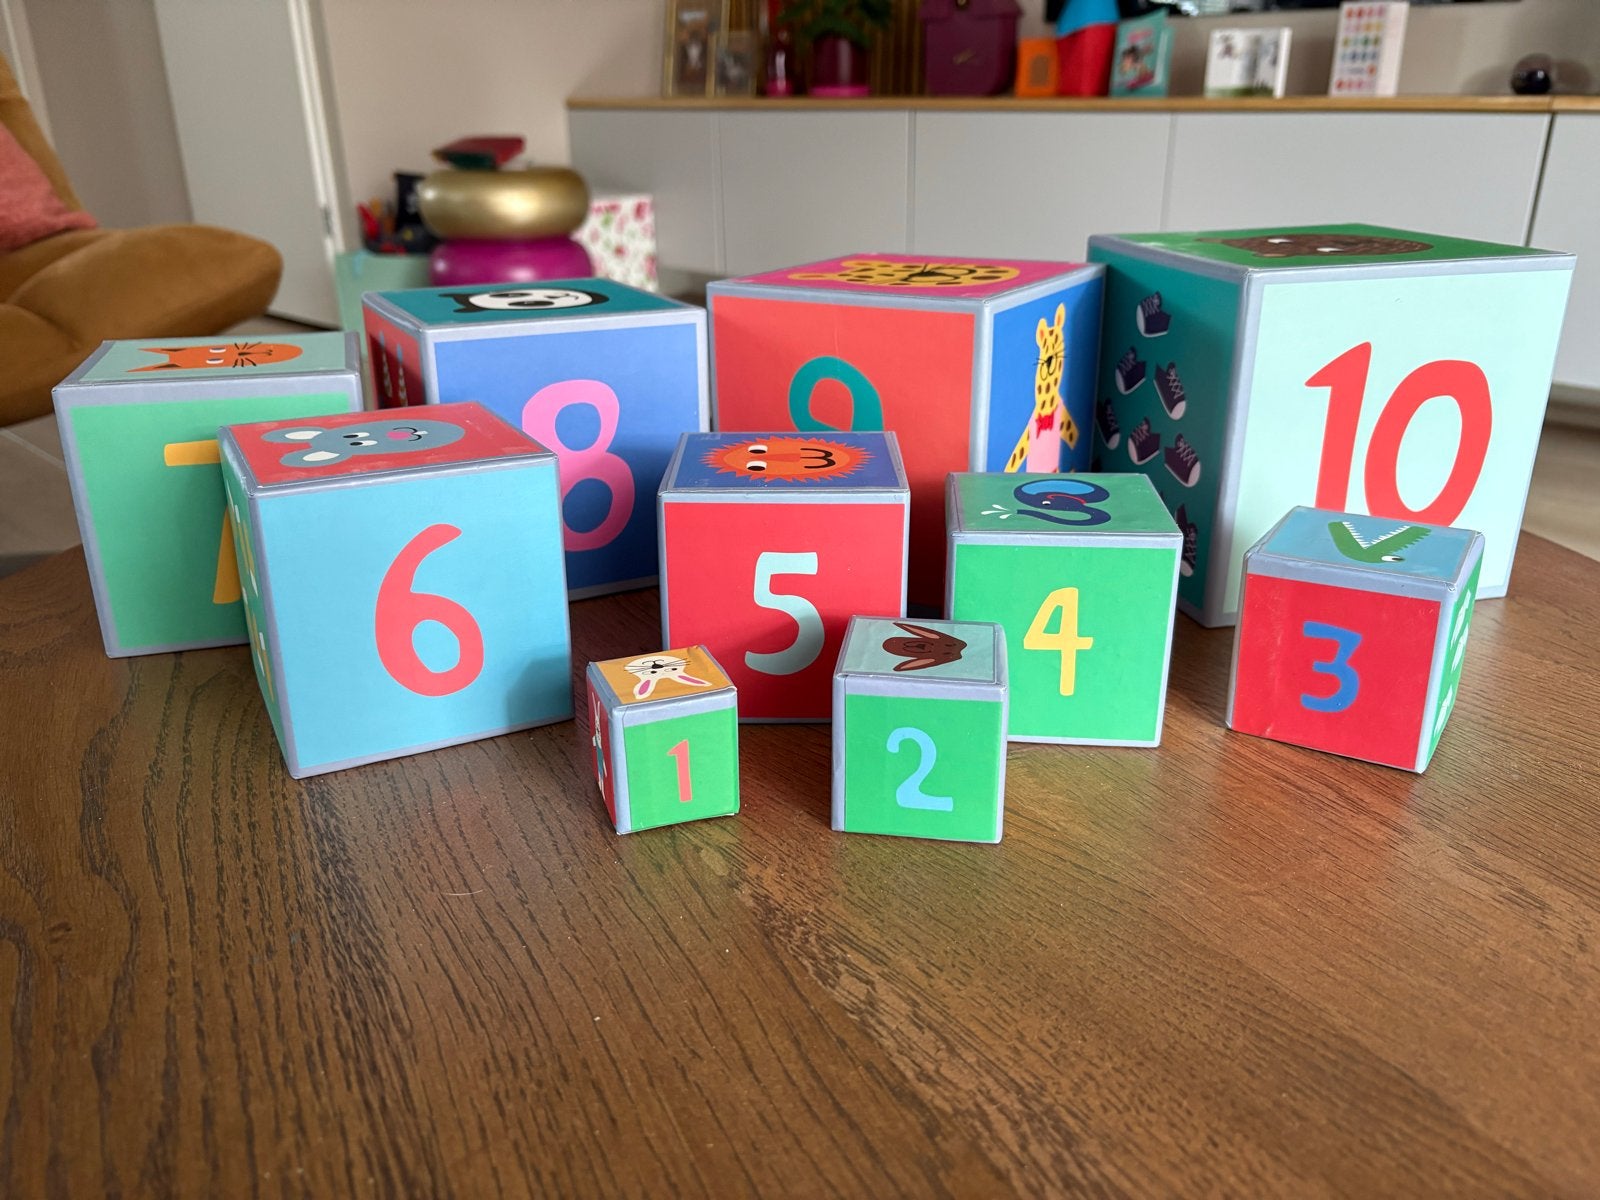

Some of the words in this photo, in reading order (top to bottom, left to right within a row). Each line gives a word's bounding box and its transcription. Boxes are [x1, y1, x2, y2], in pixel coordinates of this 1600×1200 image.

[521, 379, 636, 552] 8
[1304, 341, 1492, 527] 10
[376, 524, 484, 697] 6
[745, 551, 824, 677] 5
[1022, 587, 1094, 696] 4
[1301, 621, 1362, 712] 3
[667, 740, 692, 802] 1
[886, 726, 955, 812] 2
